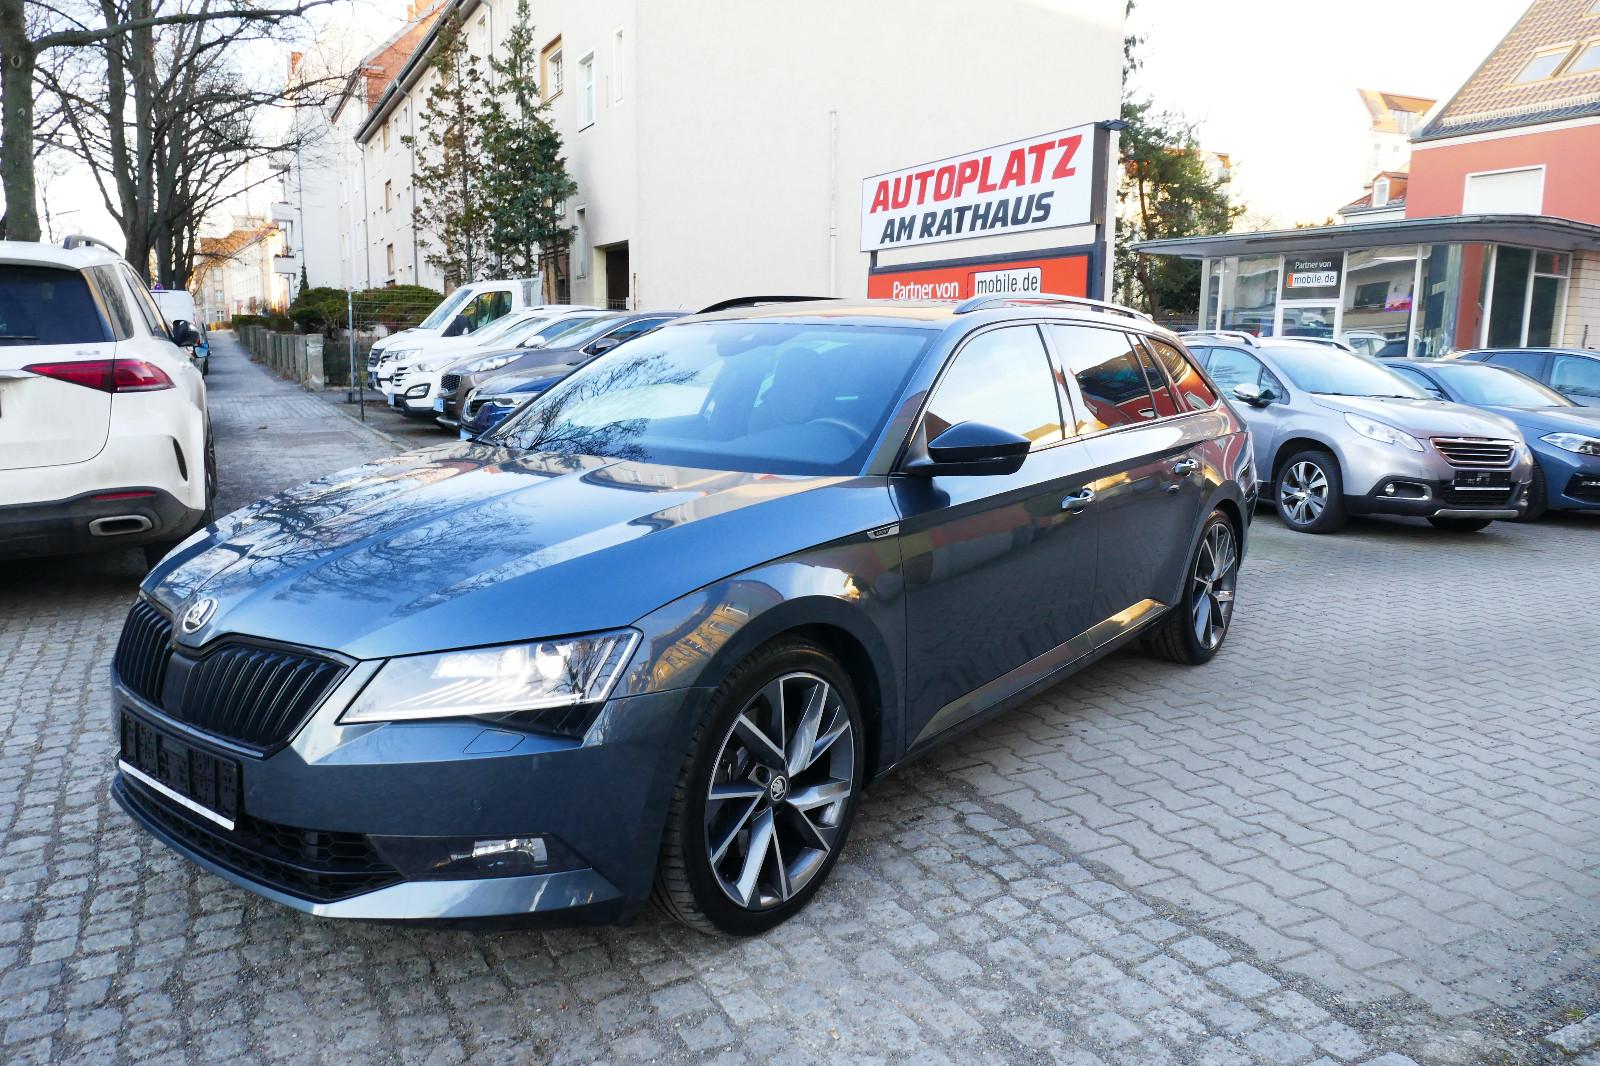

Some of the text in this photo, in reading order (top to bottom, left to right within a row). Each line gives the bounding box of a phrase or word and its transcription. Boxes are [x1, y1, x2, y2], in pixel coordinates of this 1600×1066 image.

[869, 134, 1082, 213] AUTOPLATZ
[880, 190, 1054, 244] AM RATHAUS
[1294, 273, 1335, 284] mobile.de
[1295, 261, 1318, 269] Partner
[892, 272, 1038, 300] Partner von mobile.de
